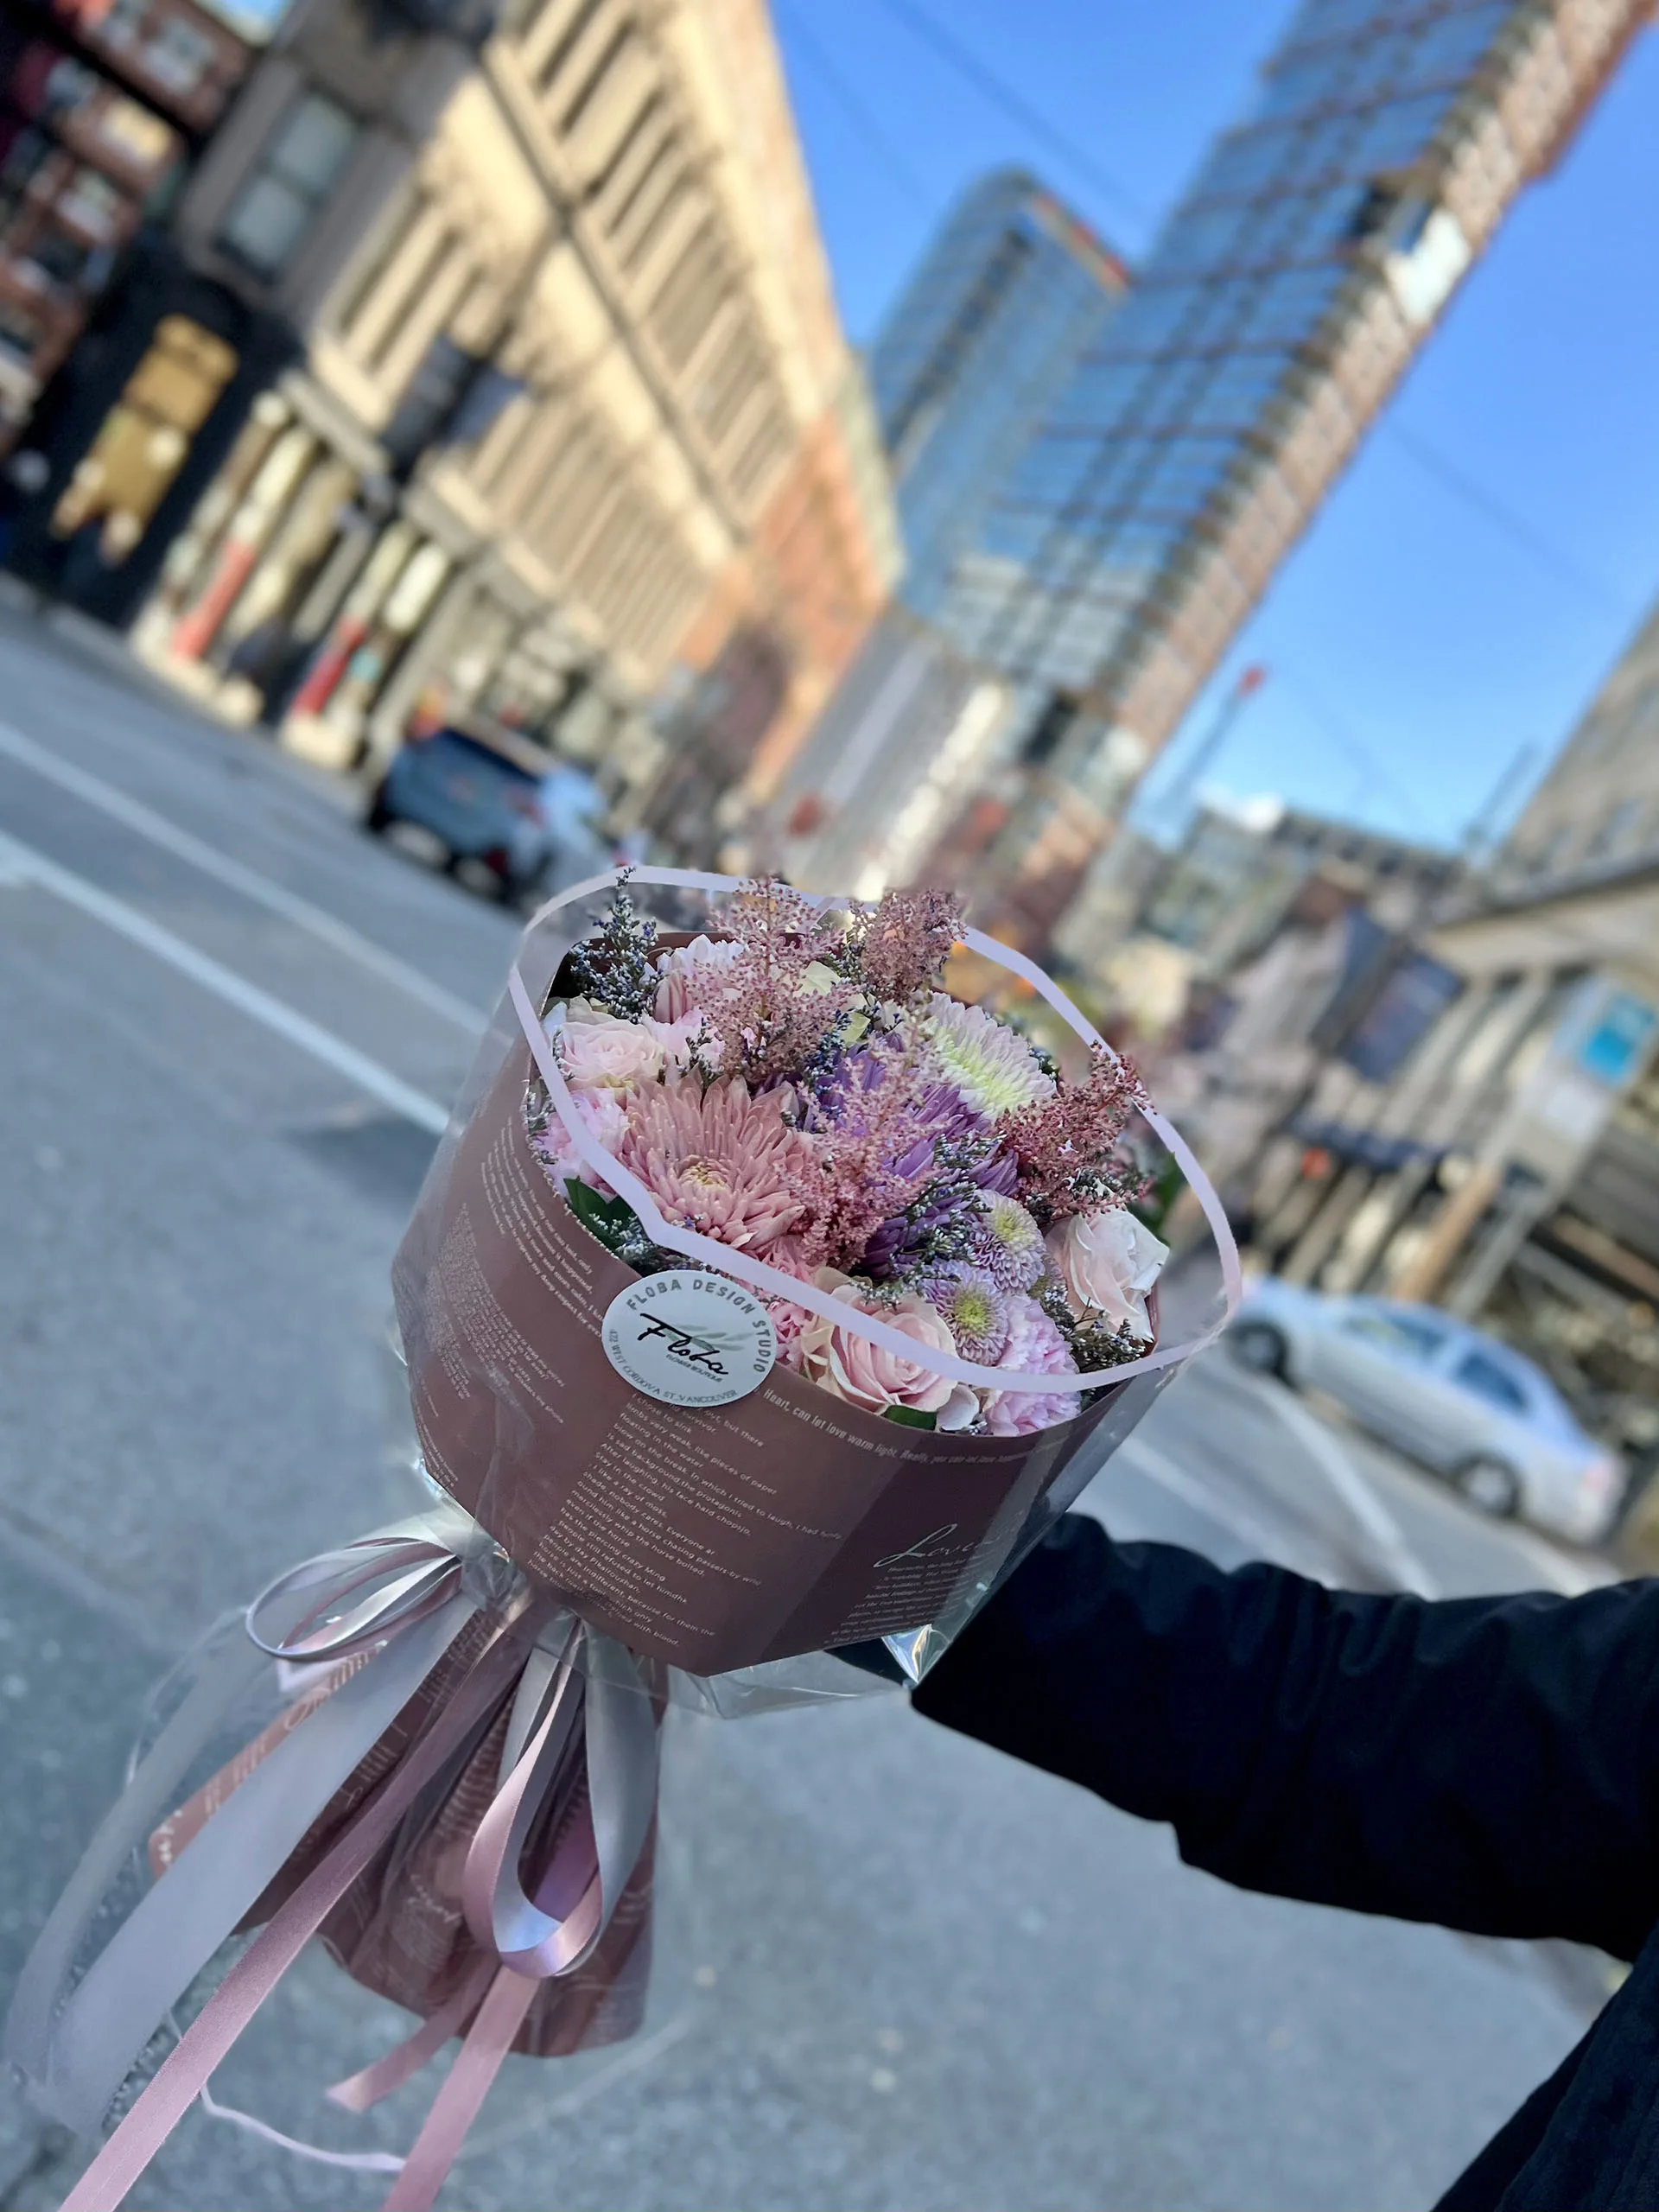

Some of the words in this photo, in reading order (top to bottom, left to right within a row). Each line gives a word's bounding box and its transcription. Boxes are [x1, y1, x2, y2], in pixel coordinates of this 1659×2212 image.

[626, 1279, 682, 1311] FLOBA
[692, 1279, 756, 1315] DESIGN
[753, 1319, 772, 1373] STUDIO
